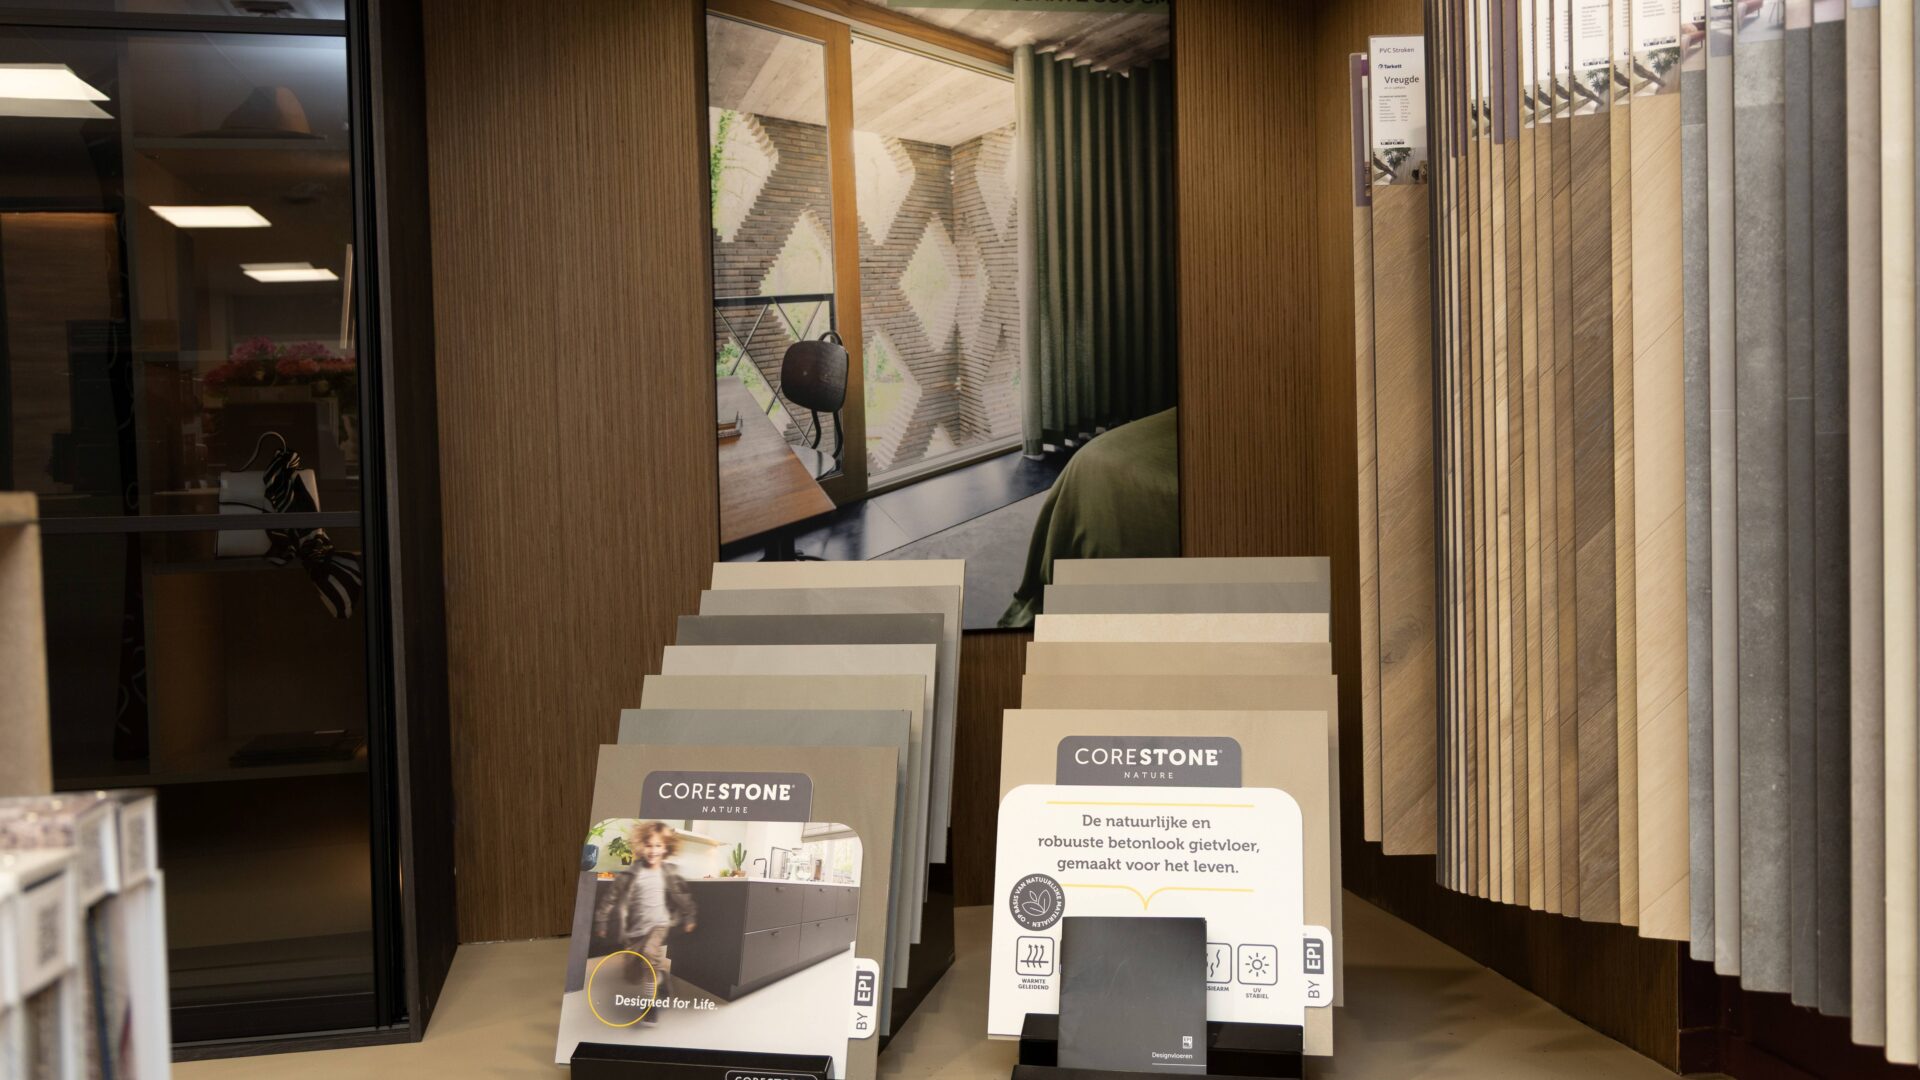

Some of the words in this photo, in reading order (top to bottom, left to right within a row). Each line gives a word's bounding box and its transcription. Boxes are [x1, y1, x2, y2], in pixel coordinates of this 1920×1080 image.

[1384, 76, 1420, 85] Vreugde
[1082, 814, 1101, 827] De
[1106, 815, 1188, 831] natuurlijke
[1192, 819, 1211, 829] en
[1038, 835, 1104, 848] robuuste
[1108, 837, 1185, 850] betonlook
[1188, 838, 1260, 854] gietvloer,
[1057, 858, 1122, 872] gemaakt
[1126, 861, 1160, 872] voor
[1164, 859, 1189, 872] het
[1194, 860, 1239, 874] leven.
[1015, 882, 1027, 895] VAN
[1026, 876, 1062, 900] NATUURLIJKE
[1017, 913, 1026, 922] OP
[1032, 900, 1062, 928] MATERIALEN
[1305, 942, 1321, 970] EPI
[856, 975, 873, 1002] EPI
[1308, 980, 1320, 998] BY
[615, 994, 670, 1009] Designed
[673, 997, 691, 1008] for
[693, 998, 718, 1010] Life.
[856, 1012, 868, 1030] BY
[1151, 1051, 1193, 1060] Designvloeren
